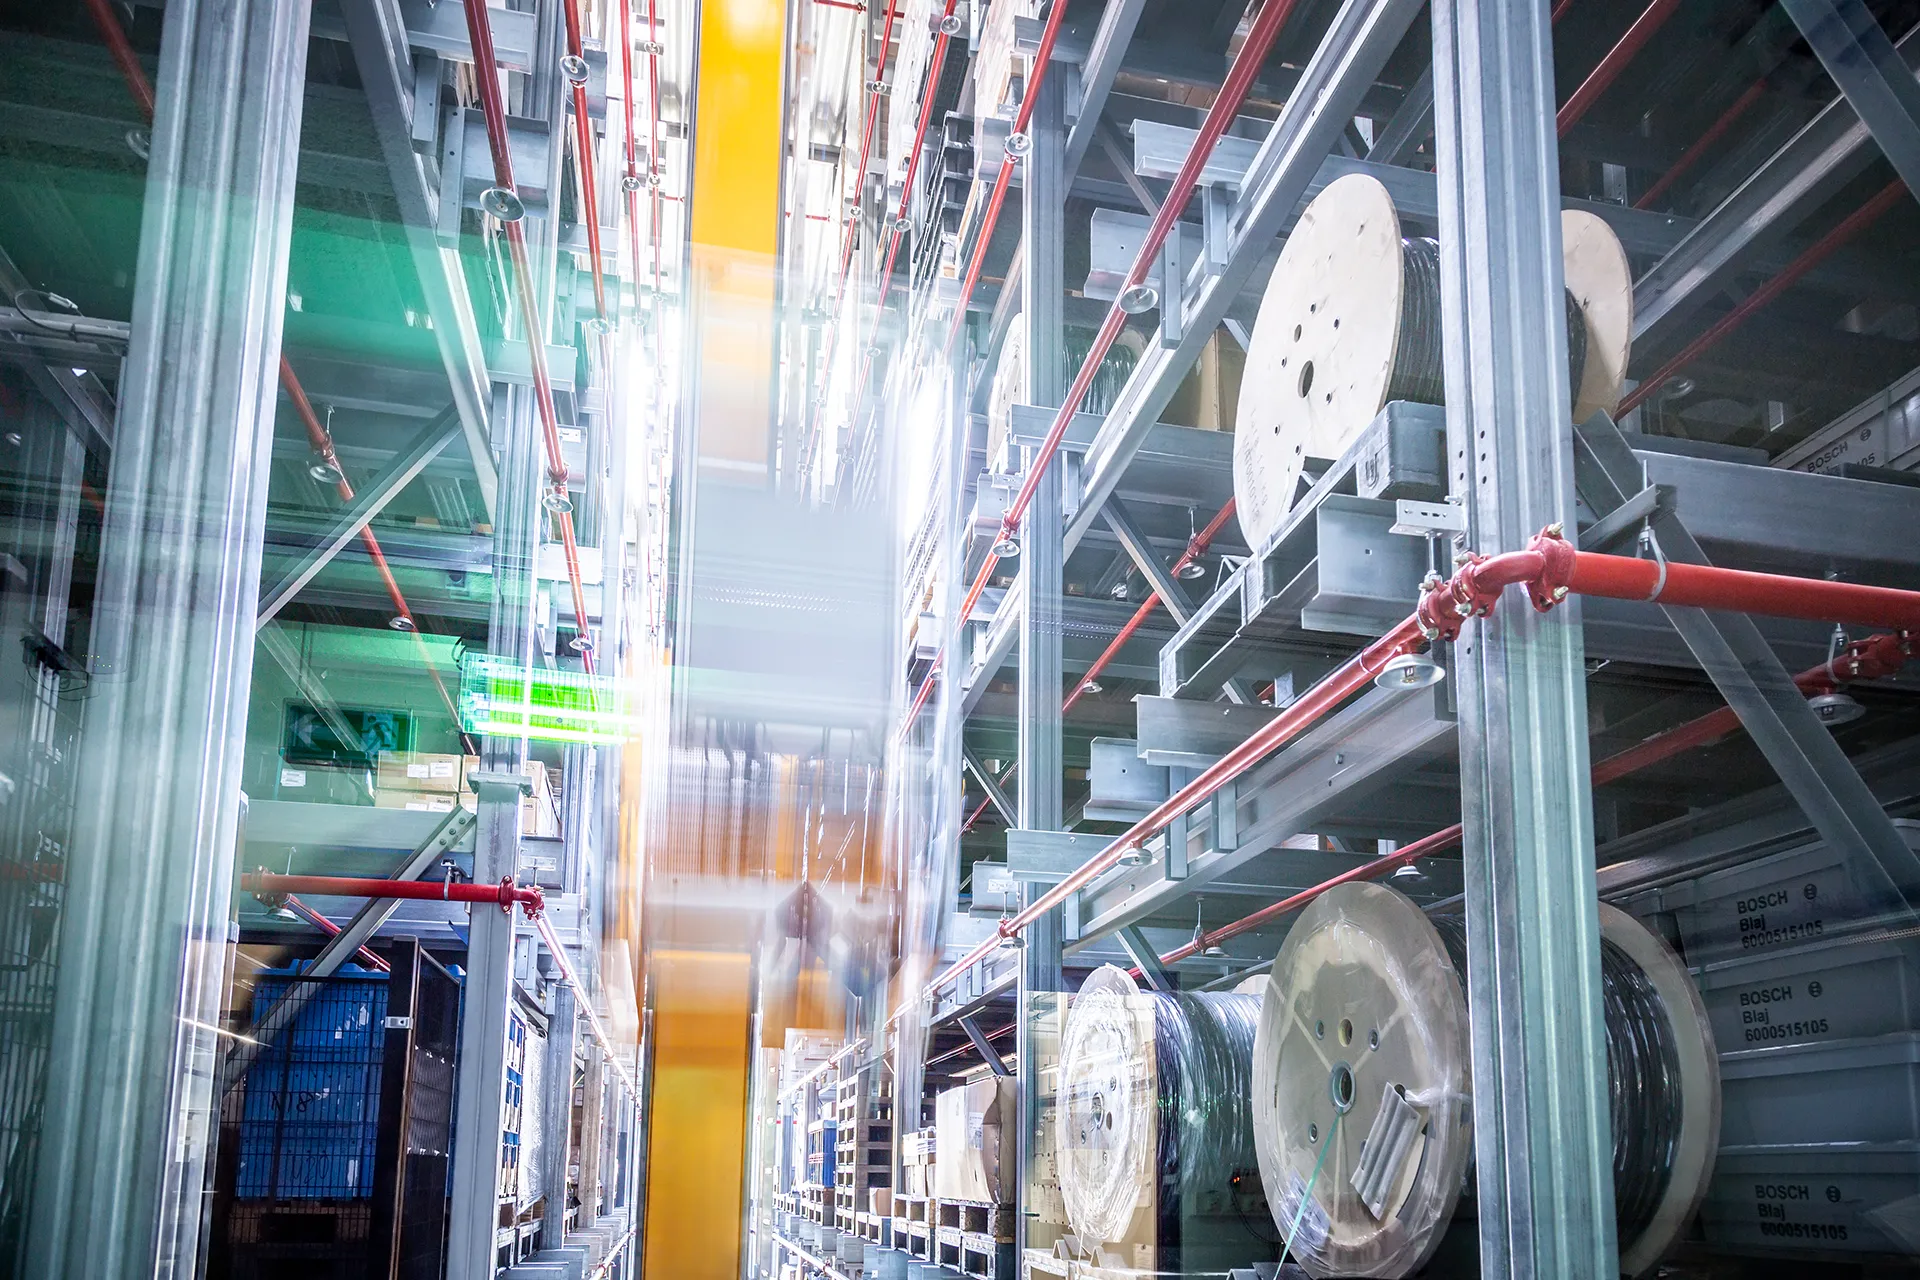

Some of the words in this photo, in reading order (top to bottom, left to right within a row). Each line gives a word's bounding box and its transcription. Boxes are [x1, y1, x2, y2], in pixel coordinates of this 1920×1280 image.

[1807, 441, 1848, 473] BOSCH
[1737, 890, 1788, 914] BOSCH
[1740, 914, 1765, 932] Blaj
[1741, 920, 1823, 949] 6000515105
[1740, 985, 1792, 1006] BOSCH
[1743, 1008, 1769, 1024] Blaj
[1745, 1019, 1829, 1042] 6000515105
[1755, 1185, 1809, 1200] BOSCH
[1758, 1203, 1785, 1221] Blaj
[1760, 1222, 1848, 1240] 6000515105
